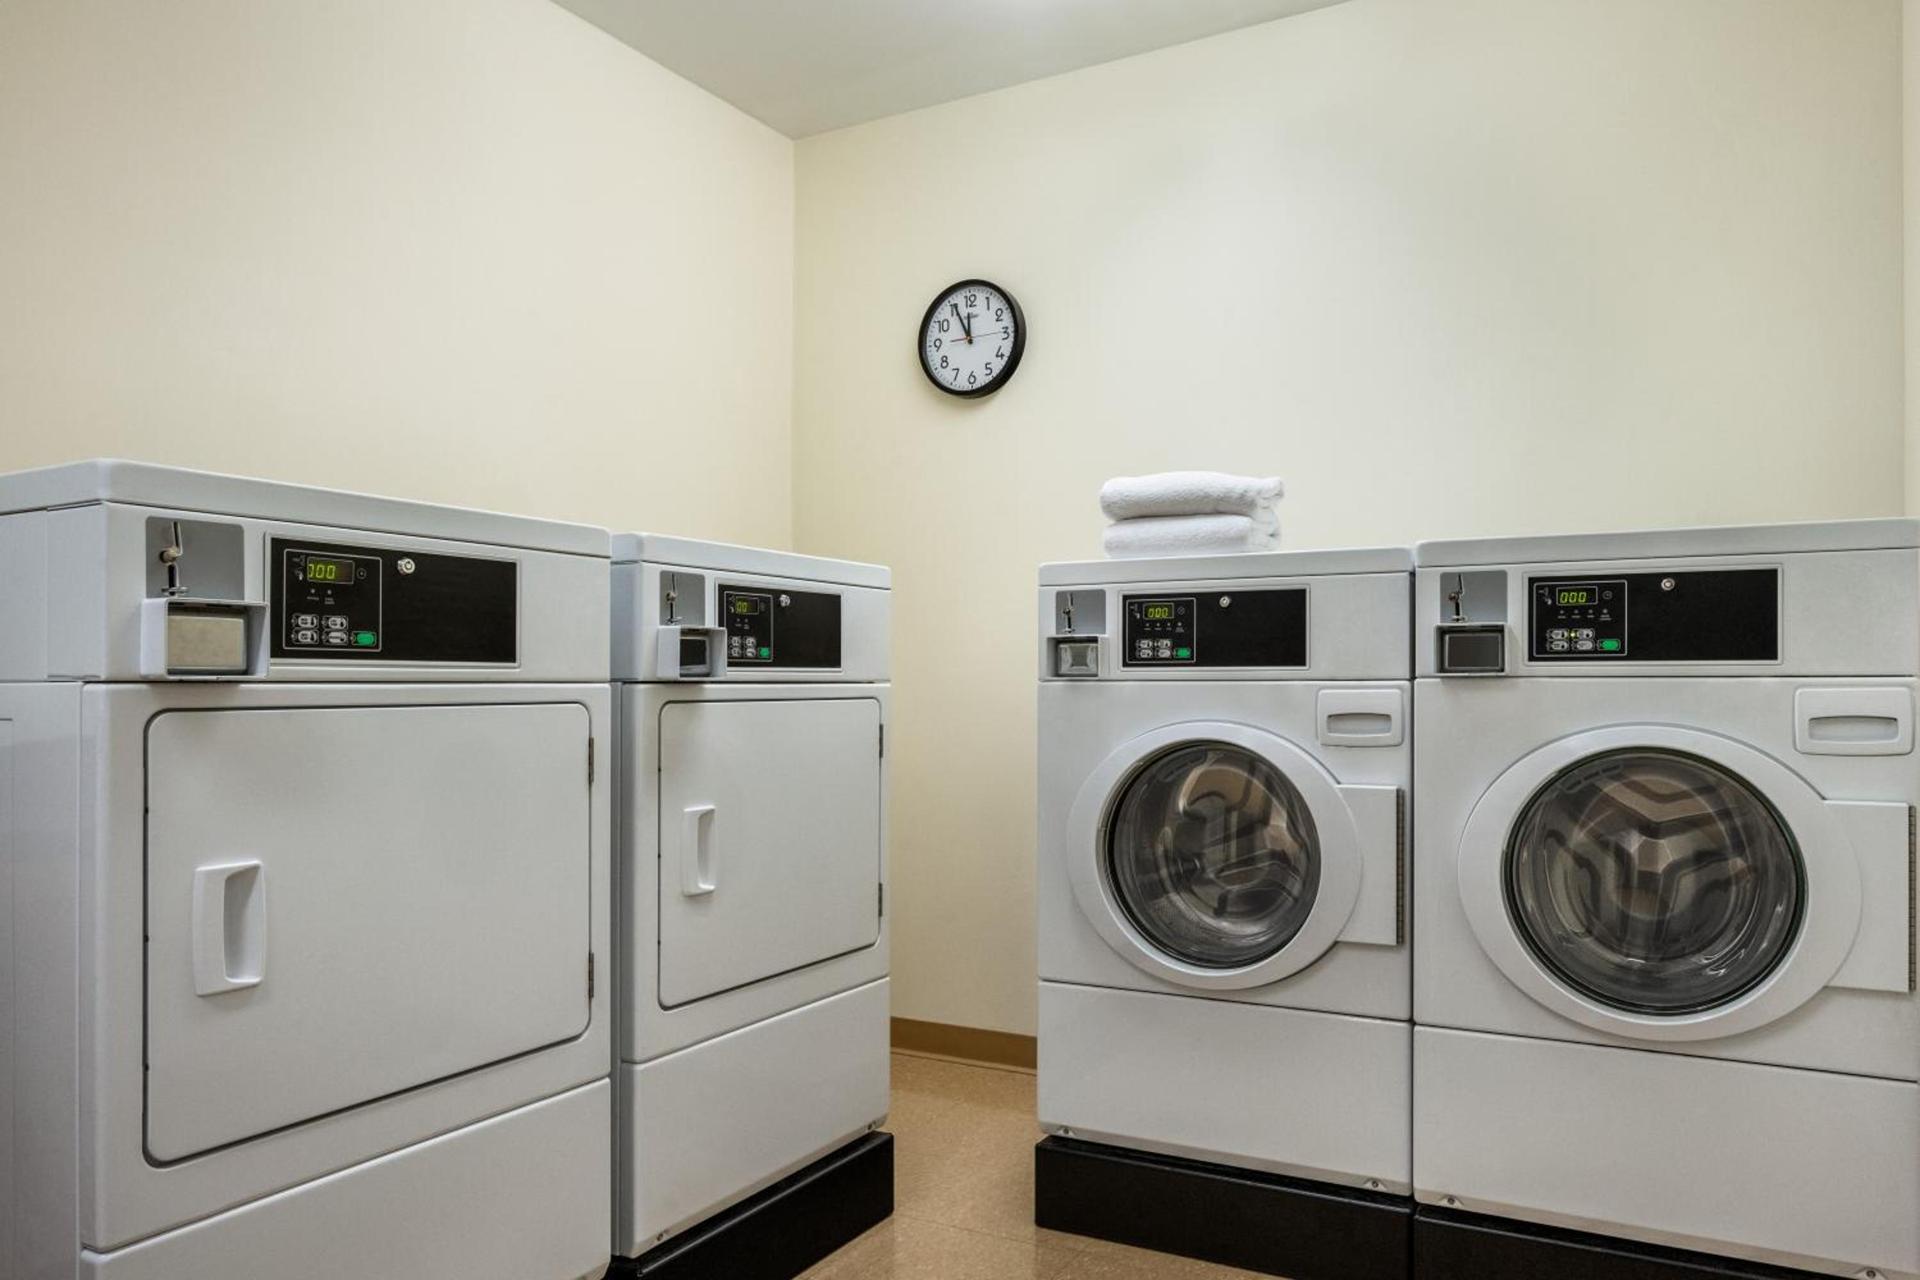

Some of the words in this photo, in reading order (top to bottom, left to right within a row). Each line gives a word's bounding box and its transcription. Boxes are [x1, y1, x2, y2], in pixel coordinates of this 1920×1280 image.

[964, 294, 977, 308] 12
[985, 297, 990, 311] 1
[995, 308, 1003, 322] 2
[936, 319, 950, 333] 10
[1002, 326, 1010, 340] 3
[934, 338, 942, 352] 9
[995, 346, 1005, 360] 4
[940, 355, 949, 369] 8
[985, 362, 993, 376] 5
[952, 368, 960, 381] 7
[968, 371, 977, 385] 6
[1560, 592, 1587, 603] 000
